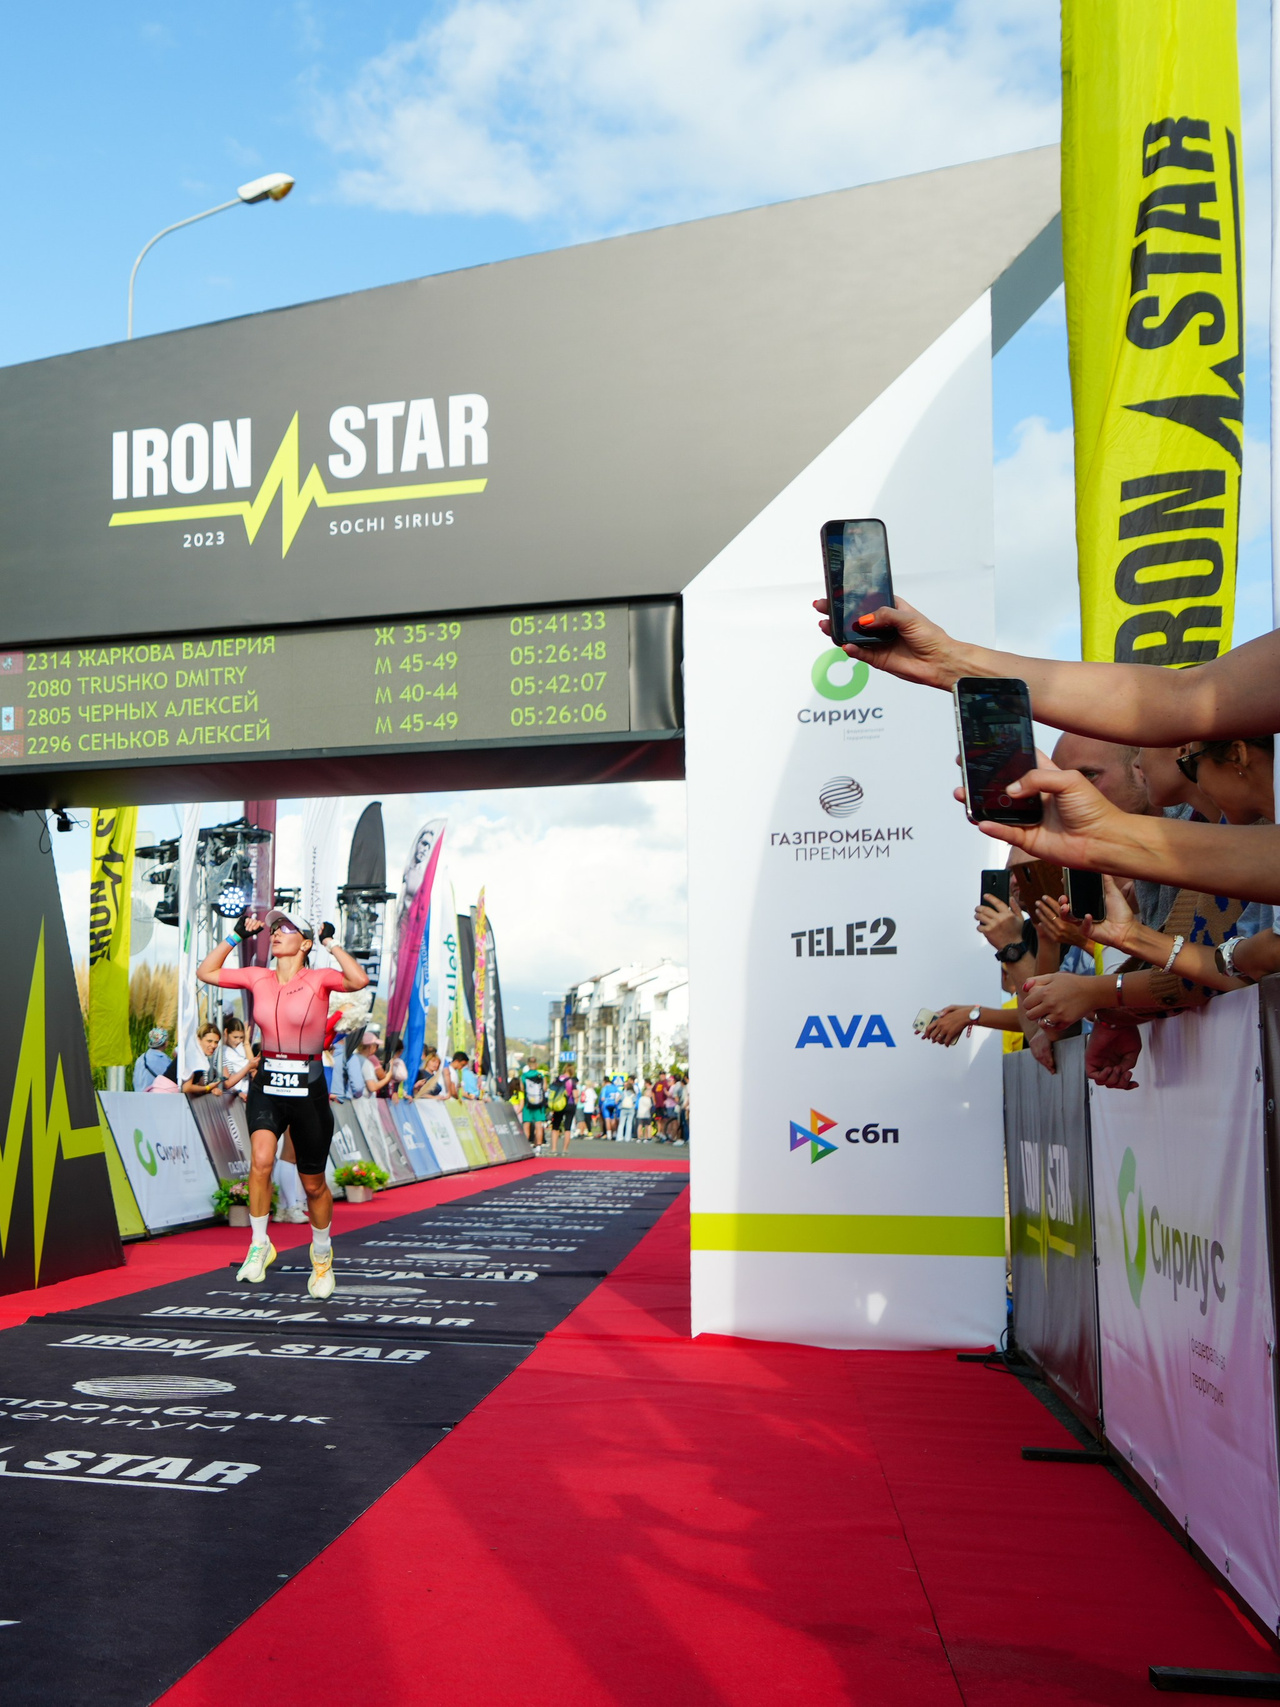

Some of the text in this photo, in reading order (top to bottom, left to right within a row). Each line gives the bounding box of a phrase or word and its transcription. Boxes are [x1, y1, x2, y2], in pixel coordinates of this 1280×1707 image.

[1125, 116, 1226, 350] STAR
[112, 393, 489, 500] IRON STAR
[183, 531, 225, 548] 2023
[329, 510, 455, 536] SOCHI SIRIUS
[1114, 469, 1225, 670] RON
[26, 611, 606, 671] 2314 ЖАРКОВА ВАЛЕРИЯ Ж 35-39 05:41:33
[26, 680, 72, 698] 2080
[77, 671, 169, 695] TRUSHKO
[176, 666, 248, 689] DMITRY
[399, 651, 458, 673] 45-49
[510, 641, 607, 666] 05:26:48
[26, 707, 72, 727] 2805
[78, 701, 158, 723] ЧЕРНЫХ
[164, 690, 259, 718] АЛЕКСЕЙ
[399, 682, 459, 703] 40-44
[510, 671, 607, 696] 05:42:07
[797, 707, 884, 725] Сириус
[26, 736, 72, 755] 2296
[78, 729, 169, 752] СЕНЬКОВ
[176, 718, 271, 746] АЛЕКСЕЙ
[399, 711, 459, 733] 45-49
[510, 703, 607, 727] 05:26:06
[770, 827, 914, 846] ГАЗПРОМБАНК
[795, 845, 890, 862] ПРЕМИУМ
[791, 917, 898, 957] TELE2
[795, 1014, 897, 1048] AVA
[270, 1072, 300, 1087] 2314
[845, 1123, 899, 1144] сбп
[1150, 1205, 1227, 1317] Сириус
[151, 1306, 475, 1327] IRON STAR
[60, 1334, 431, 1361] IRON STAR
[23, 1449, 262, 1485] STAR
